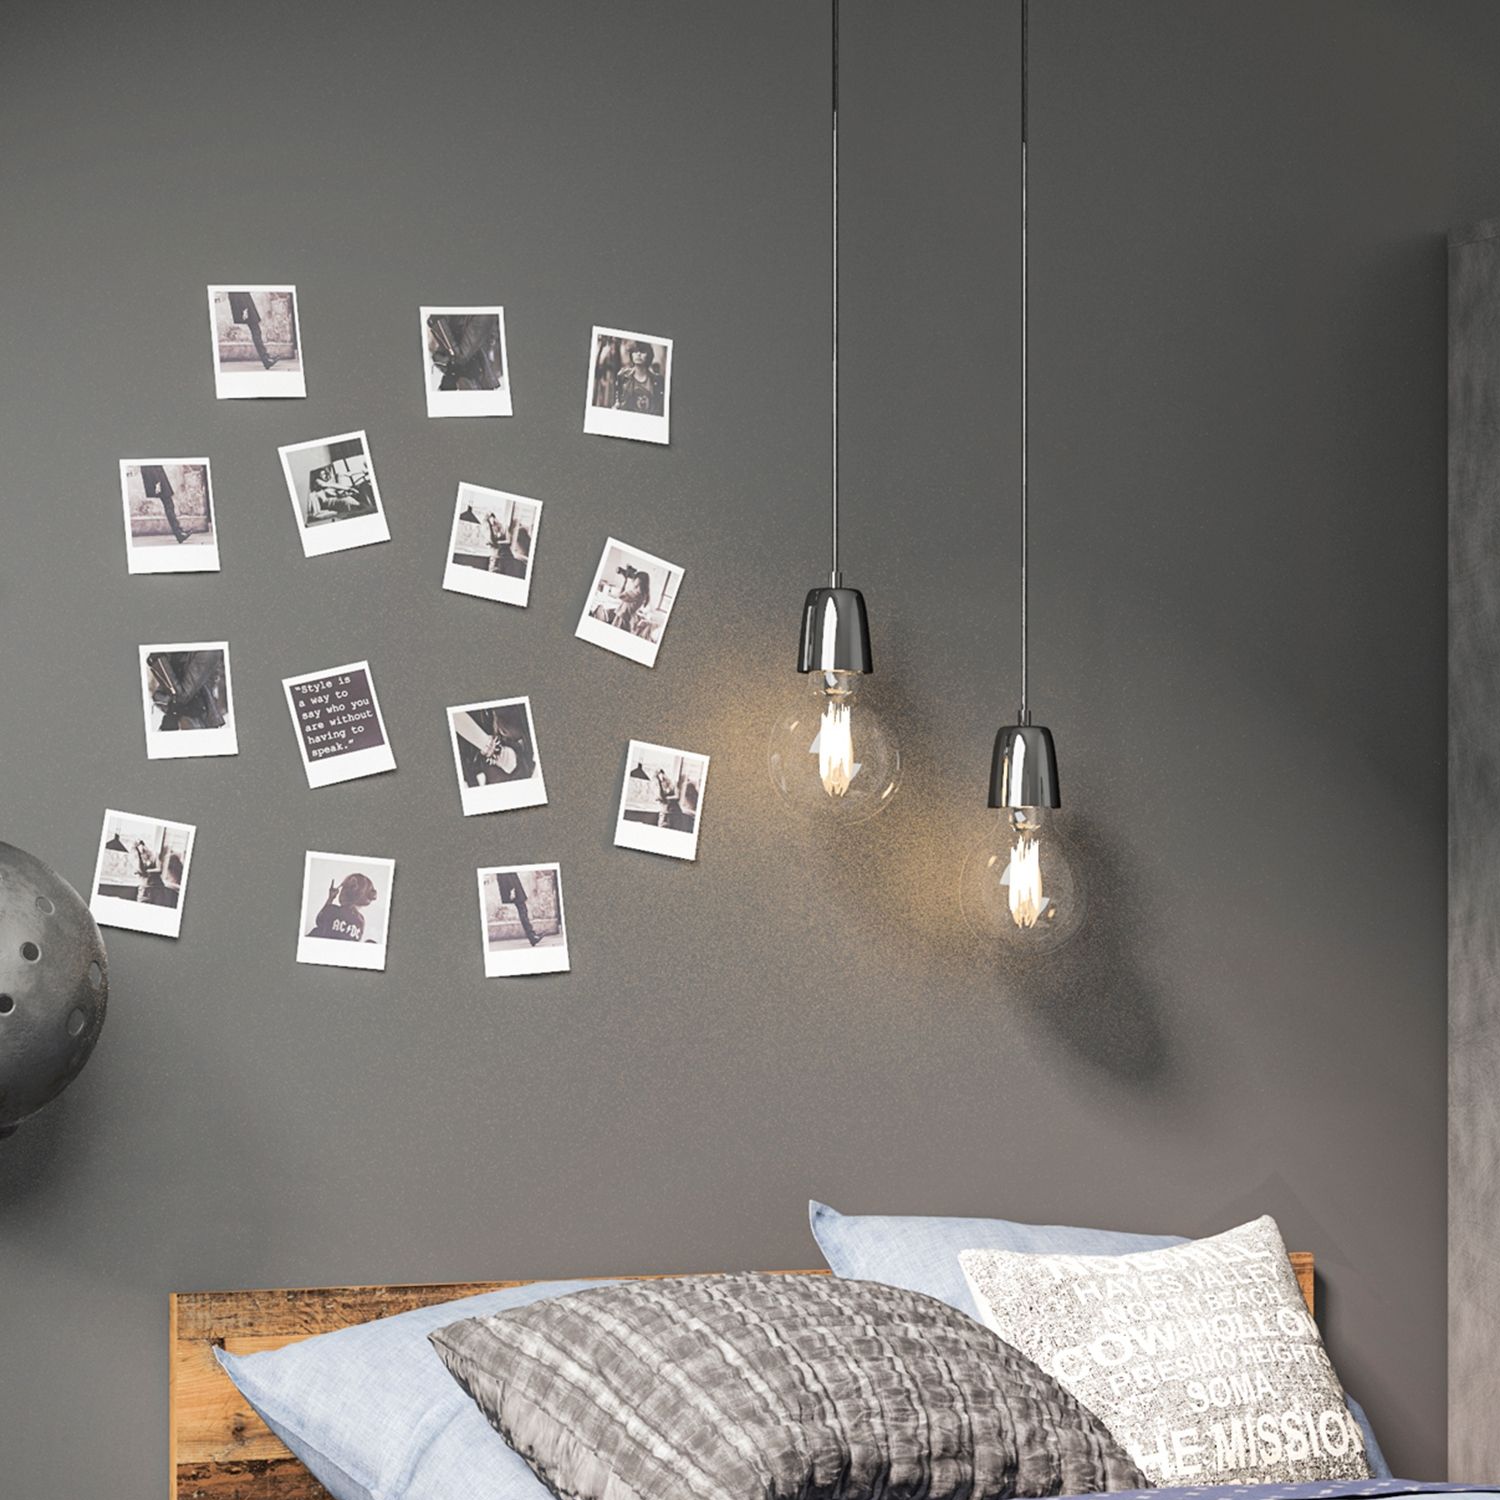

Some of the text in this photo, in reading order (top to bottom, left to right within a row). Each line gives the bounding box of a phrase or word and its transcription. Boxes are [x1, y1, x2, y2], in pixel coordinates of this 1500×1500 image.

[338, 676, 351, 685] is
[299, 690, 348, 708] a way to
[301, 698, 370, 720] say who you
[305, 710, 374, 732] are without
[307, 725, 365, 745] having to
[1074, 1261, 1281, 1302] HAYES VALLEY
[1101, 1287, 1283, 1327] NORTH BEACH
[1053, 1320, 1185, 1385] COW
[1108, 1342, 1332, 1397] PRESIDIO HEIGHTS
[1186, 1370, 1276, 1414] SOMA
